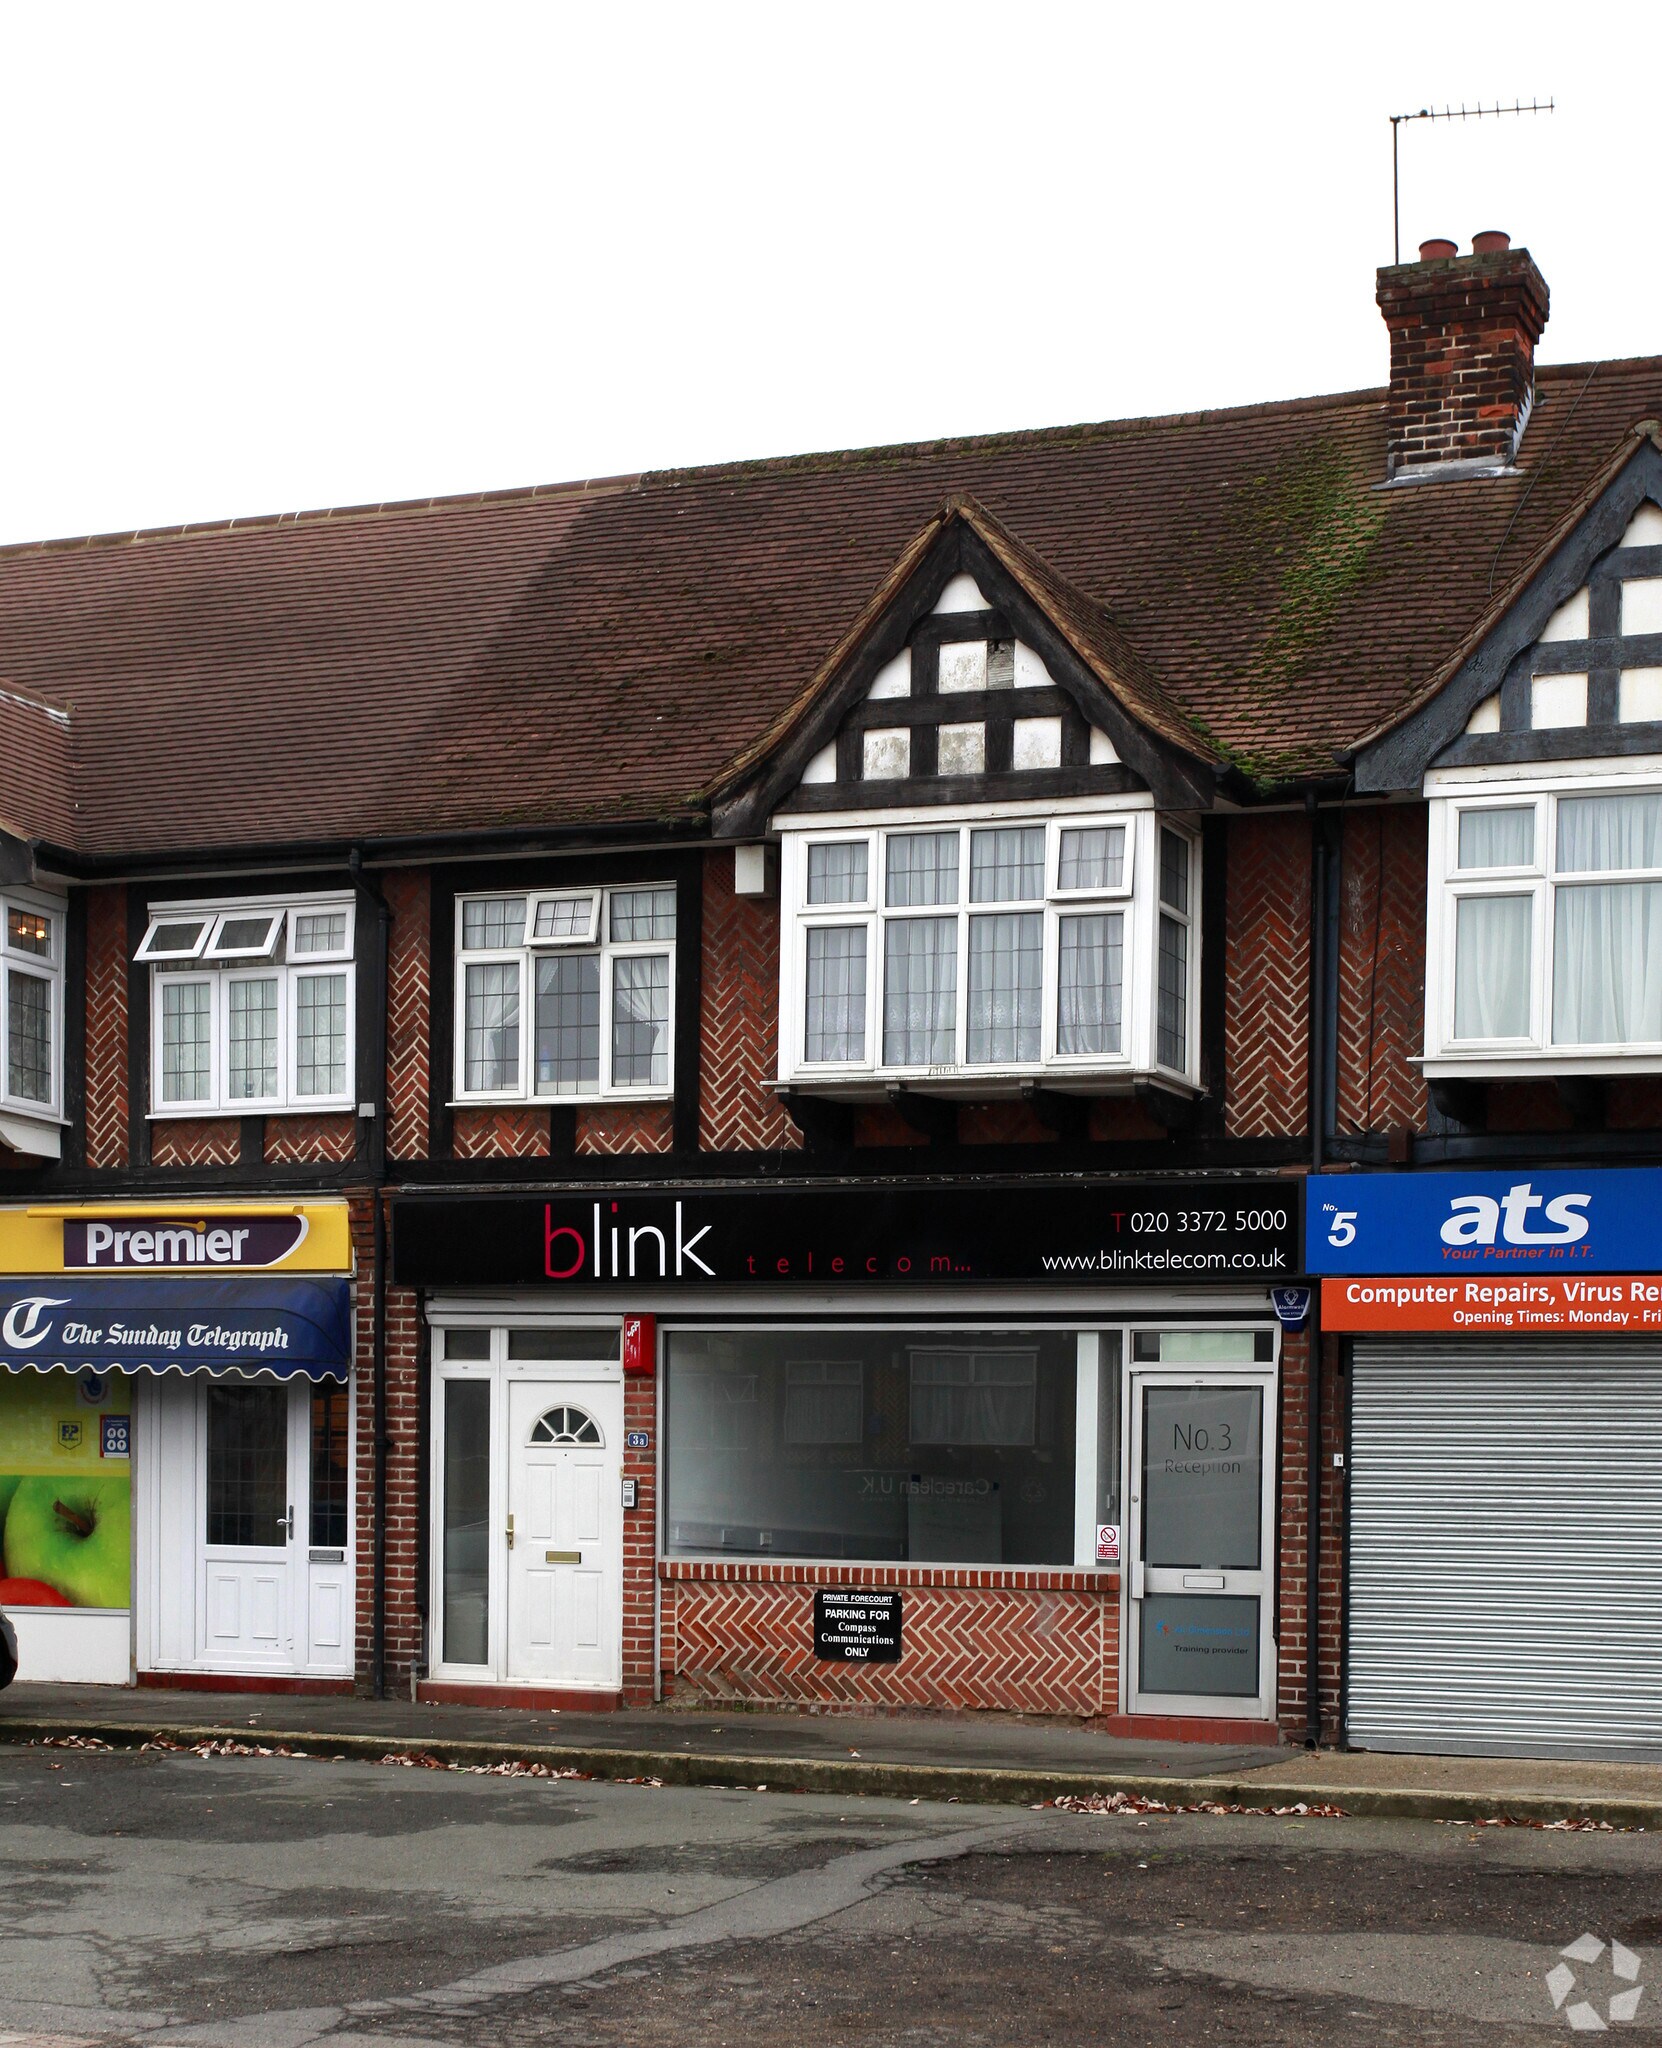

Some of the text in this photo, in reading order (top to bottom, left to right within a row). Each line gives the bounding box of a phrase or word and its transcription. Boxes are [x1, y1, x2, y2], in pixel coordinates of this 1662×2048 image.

[1322, 1203, 1338, 1211] No.
[1440, 1183, 1592, 1246] ats
[1111, 1209, 1287, 1233] T 020 3372 5000
[1327, 1211, 1358, 1247] 5
[86, 1220, 250, 1264] Premier
[544, 1201, 717, 1279] blink
[1042, 1247, 1287, 1270] www.blinktelecom.co.uk
[1442, 1245, 1594, 1260] Your Partner in I.T.
[1346, 1282, 1662, 1308] Computer Repairs, Virus Re
[1453, 1310, 1513, 1326] Opening
[1517, 1310, 1564, 1323] Times:
[1569, 1309, 1629, 1325] Monday
[62, 1322, 289, 1351] The Sunday Telegraph
[632, 1435, 645, 1446] 3a
[1173, 1424, 1232, 1452] No.3
[1165, 1459, 1240, 1476] Reception
[822, 1594, 893, 1603] PRIVATE FORECOURT
[825, 1609, 890, 1620] PARKING FOR
[838, 1622, 876, 1633] Compass
[821, 1633, 894, 1645] Communications
[845, 1647, 869, 1657] ONLY
[1174, 1645, 1249, 1655] Training provider
